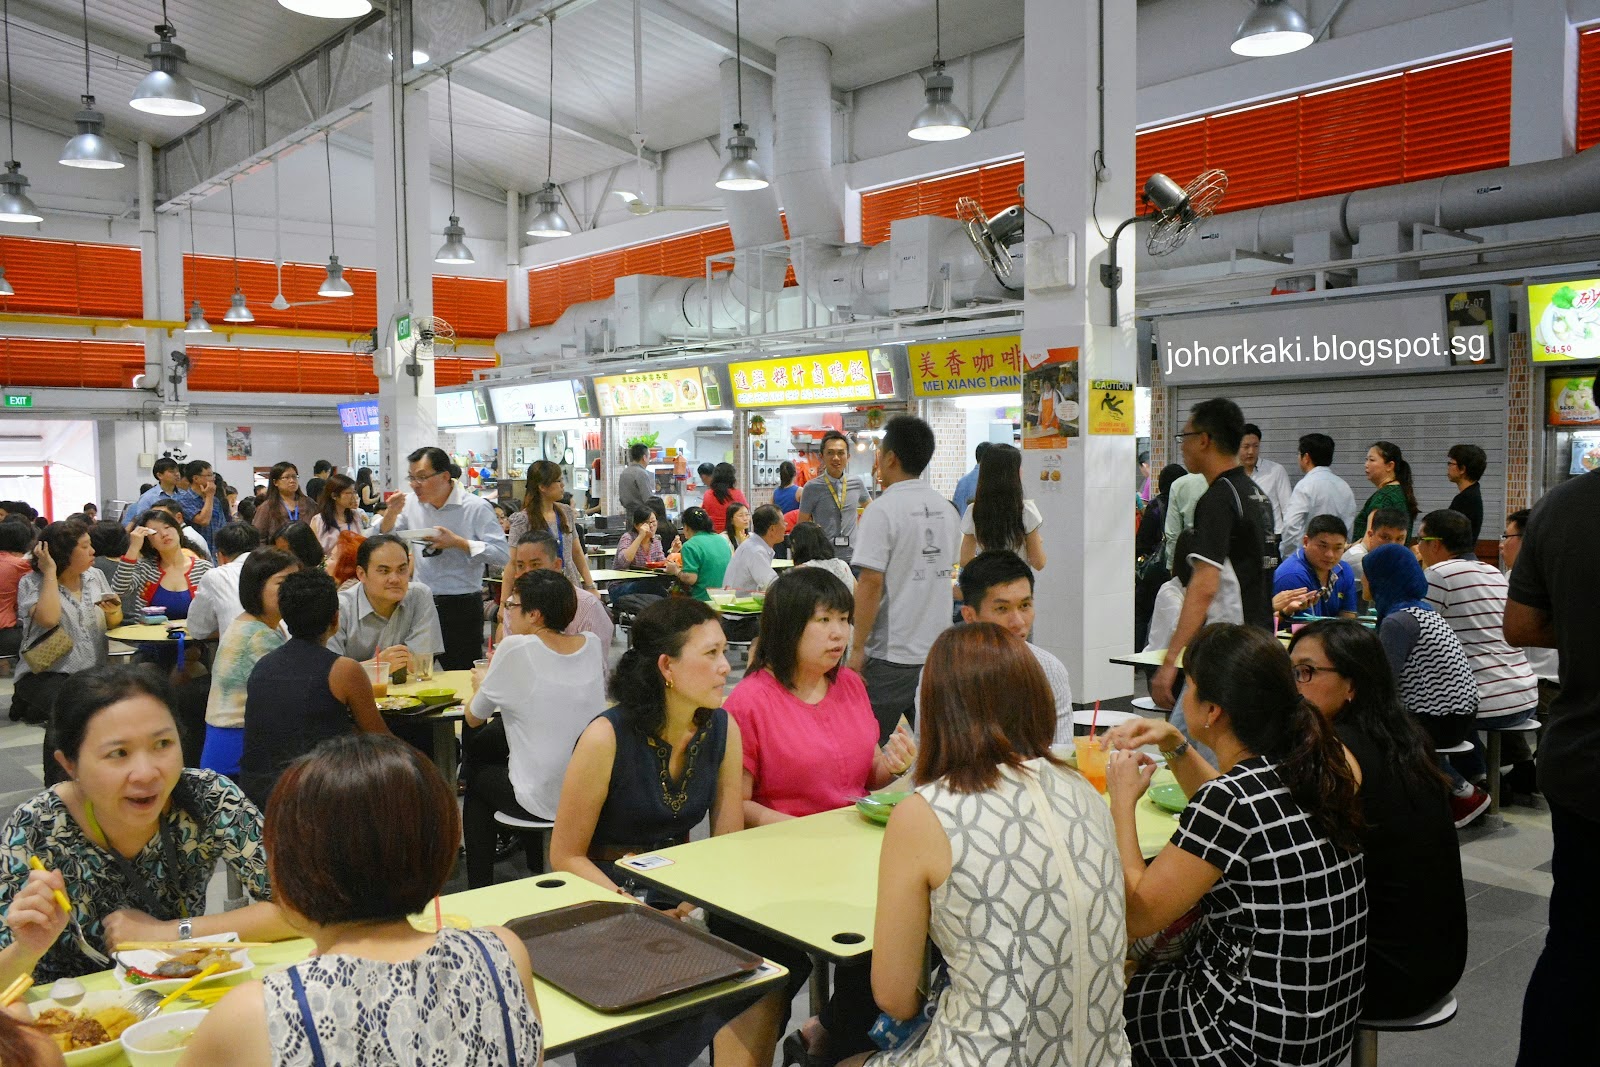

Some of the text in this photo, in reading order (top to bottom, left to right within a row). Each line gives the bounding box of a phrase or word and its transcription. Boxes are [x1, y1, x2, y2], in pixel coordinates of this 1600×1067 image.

[1545, 343, 1572, 354] $4.50
[918, 344, 1021, 378] 美香咖啡
[923, 380, 944, 391] MEI
[947, 377, 987, 390] XIANG
[1094, 381, 1130, 391] CAUTION
[10, 396, 27, 405] EXIT
